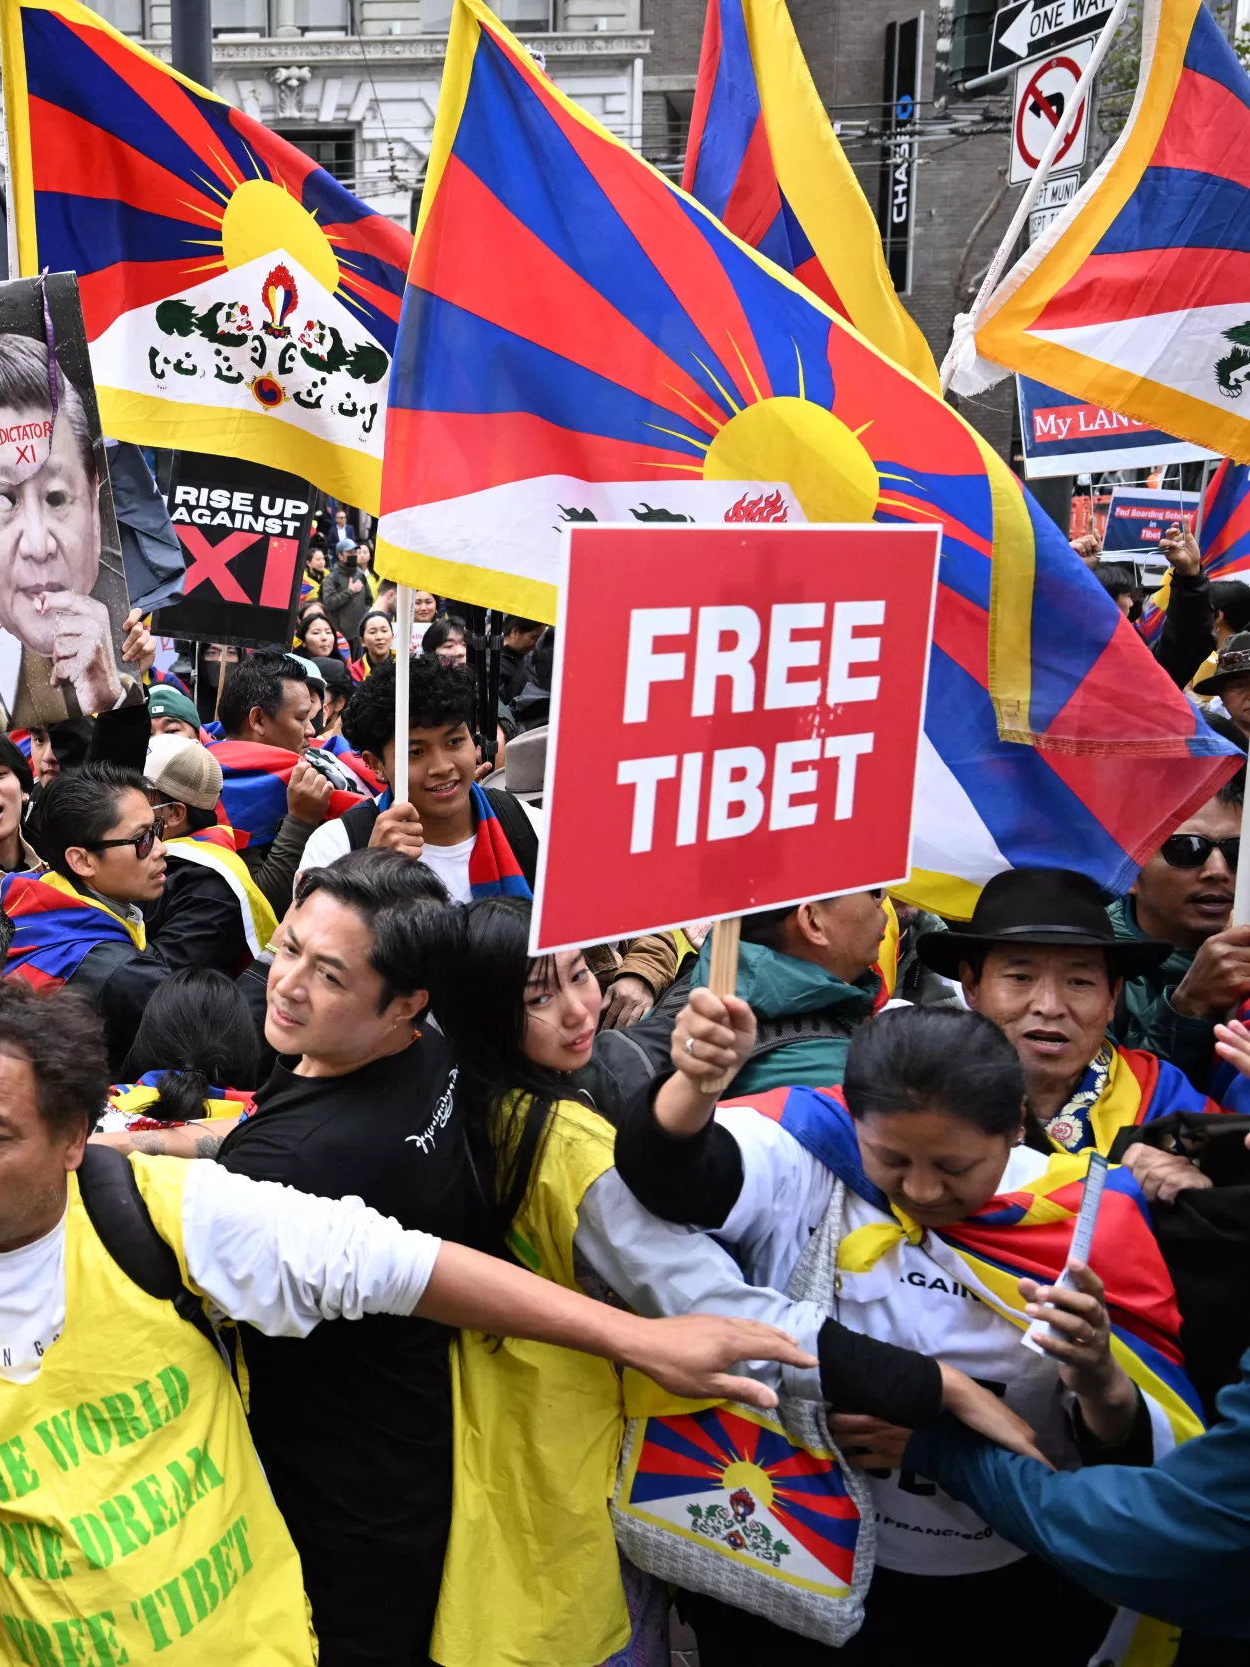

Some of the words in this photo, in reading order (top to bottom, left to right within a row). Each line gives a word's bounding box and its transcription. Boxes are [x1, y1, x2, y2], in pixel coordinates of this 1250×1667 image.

[1030, 2, 1066, 37] ONE
[893, 124, 911, 223] CHASE
[1050, 182, 1075, 204] MUNI
[1034, 414, 1072, 439] My
[1078, 409, 1143, 431] LAN
[15, 444, 37, 465] XI
[174, 485, 254, 513] RISE
[260, 495, 309, 518] UP
[1115, 507, 1130, 516] End
[1131, 508, 1164, 520] Boarding
[170, 506, 301, 537] AGAINST
[1141, 529, 1161, 539] Tibet
[1149, 520, 1157, 528] in
[173, 523, 300, 610] XI
[623, 600, 886, 724] FREE
[617, 732, 875, 854] TIBET
[900, 1271, 981, 1302] GAIN
[34, 1364, 191, 1473] WORLD
[69, 1438, 225, 1571] DREAM
[130, 1515, 254, 1653] TIBET
